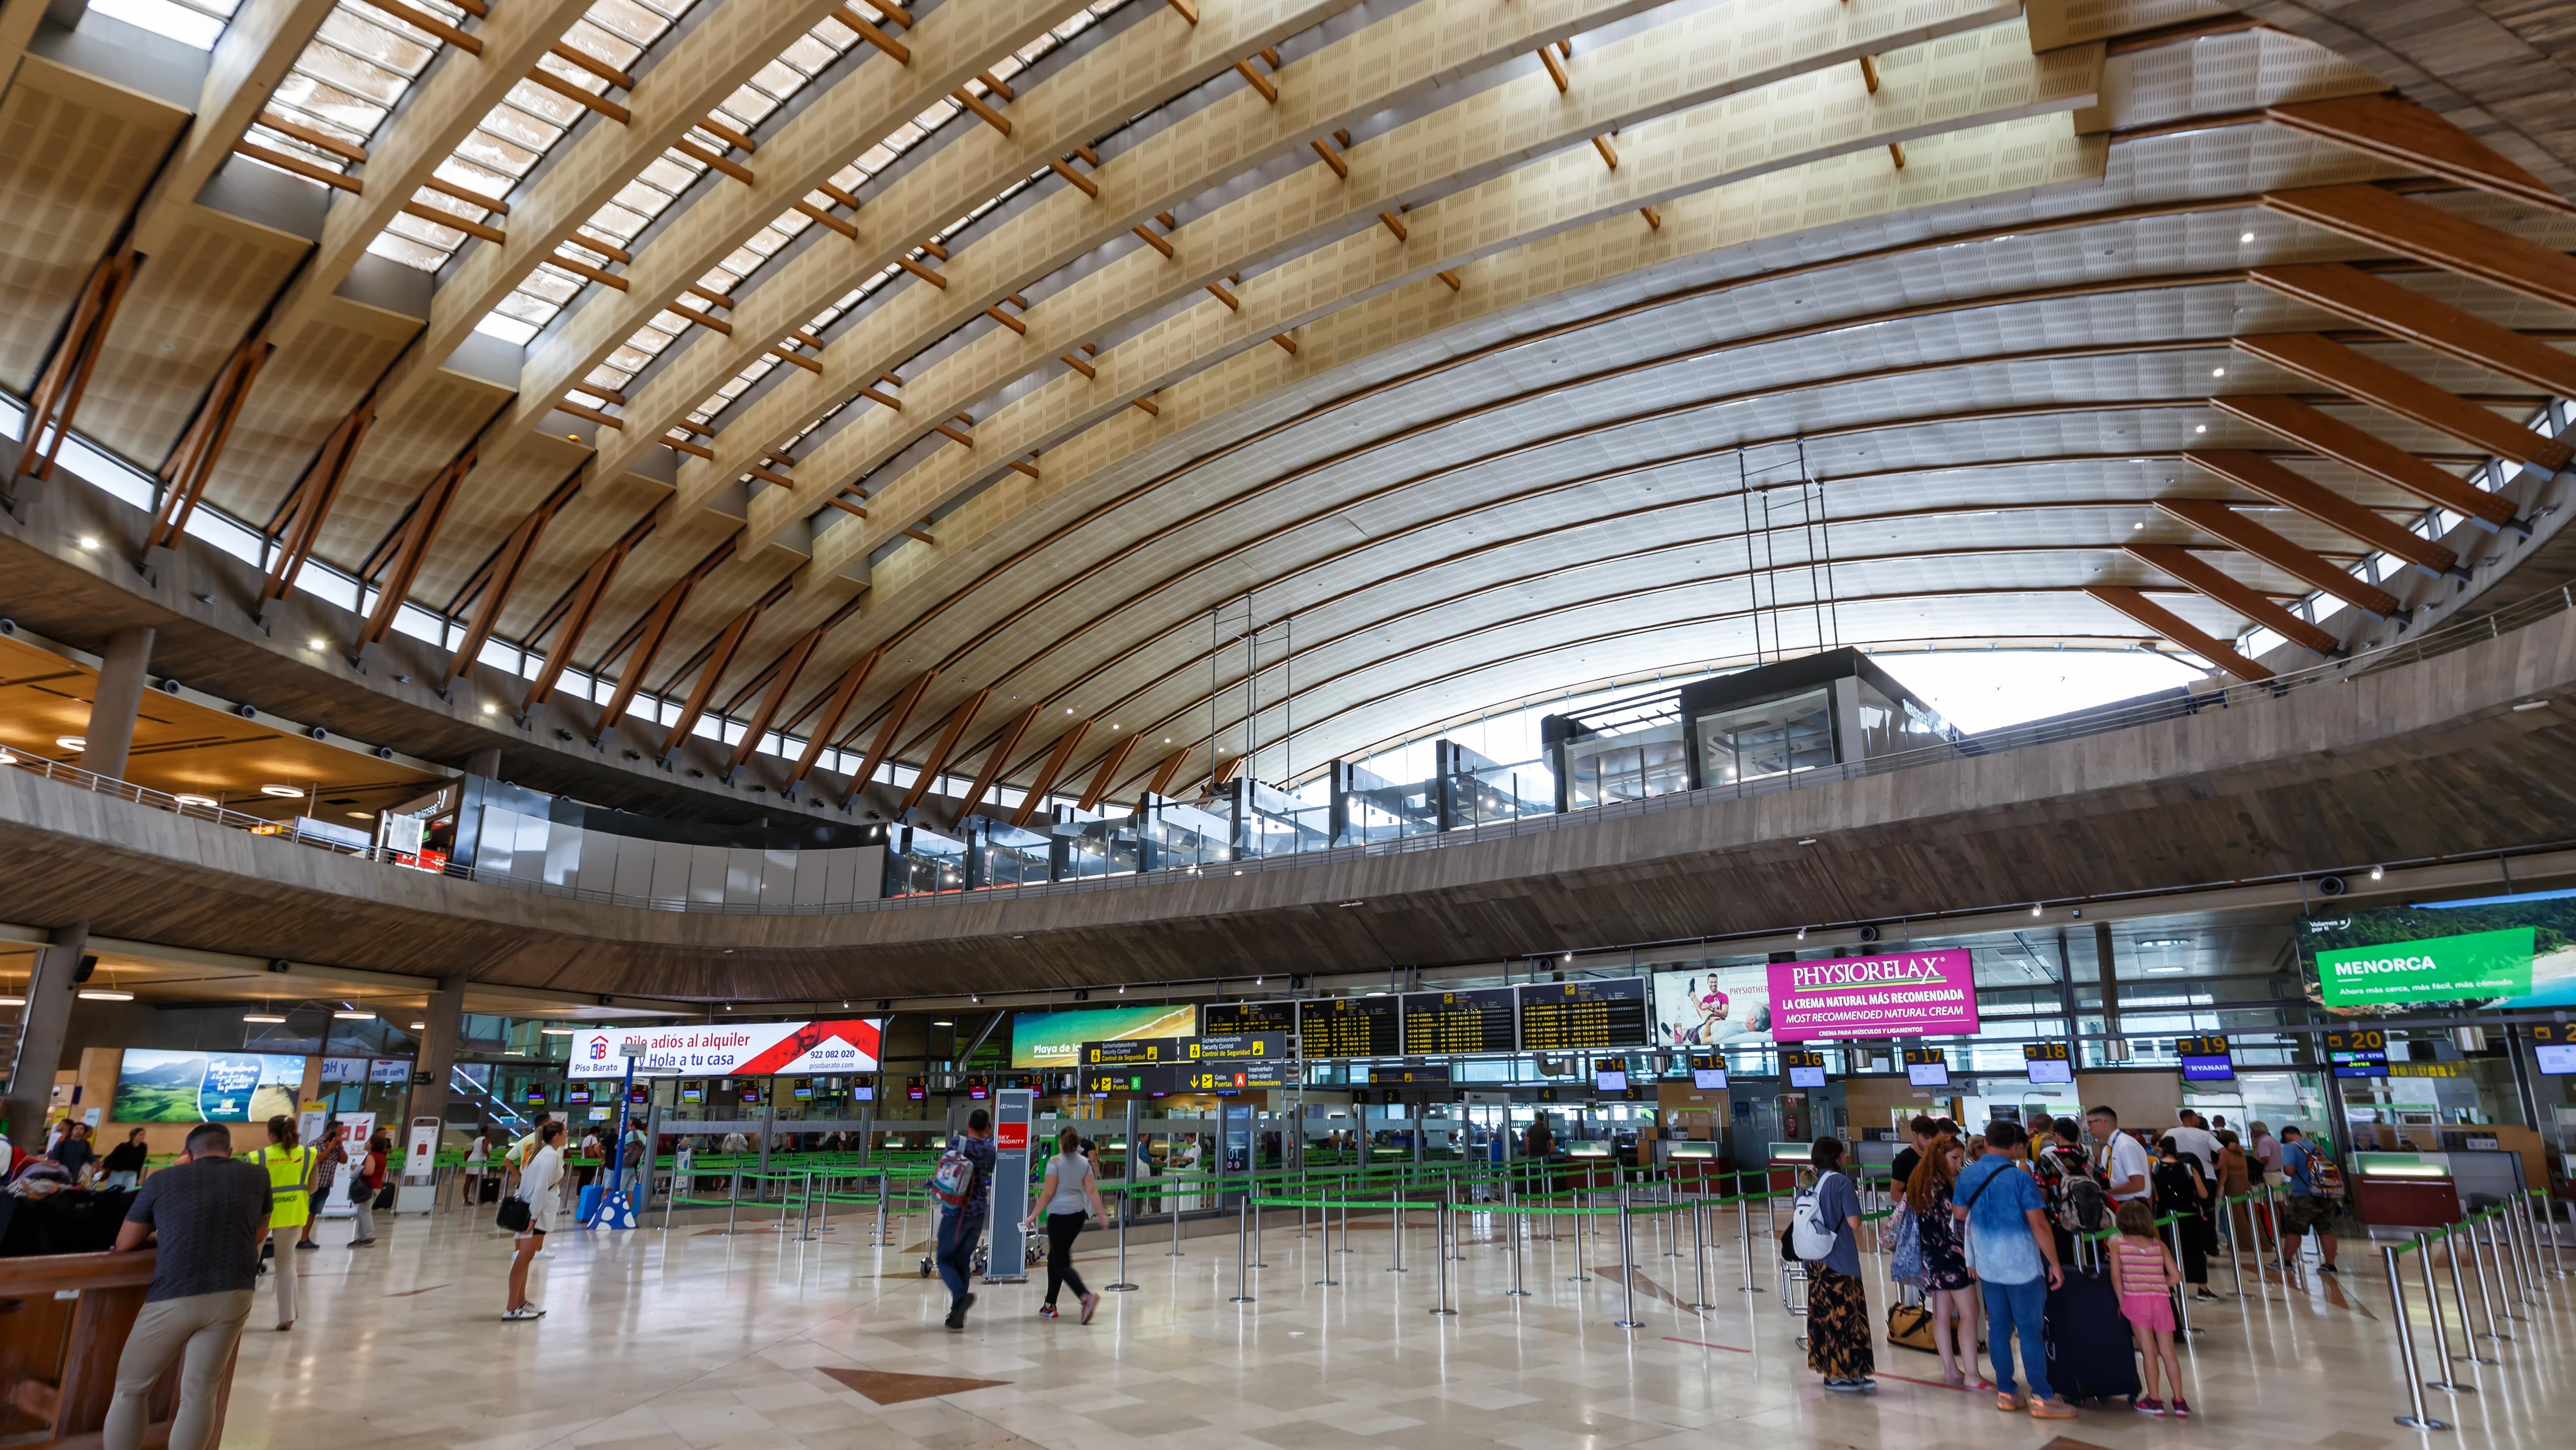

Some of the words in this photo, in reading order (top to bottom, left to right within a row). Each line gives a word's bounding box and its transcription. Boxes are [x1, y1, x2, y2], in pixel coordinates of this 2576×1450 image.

[2335, 956, 2436, 975] MENORCA
[2476, 979, 2513, 987] cómodo
[1782, 1000, 1793, 1010] LA
[1795, 997, 1825, 1009] CREMA
[1826, 995, 1867, 1007] NATURAL
[1869, 992, 1890, 1005] MÁS
[1892, 989, 1964, 1003] RECOMENDADA
[1786, 1014, 1811, 1024] MOST
[1812, 1010, 1883, 1022] RECOMMENDED
[1885, 1008, 1927, 1020] NATURAL
[1929, 1006, 1963, 1017] CREAM
[652, 1034, 683, 1048] adiós
[688, 1034, 698, 1047] al
[702, 1032, 750, 1050] alquiler
[2201, 1037, 2225, 1053] 19
[2351, 1031, 2381, 1049] 20
[1034, 1044, 1057, 1055] Playa
[1061, 1044, 1070, 1052] de
[2044, 1045, 2066, 1059] 18
[650, 1053, 675, 1067] Hola
[680, 1055, 686, 1066] a
[691, 1053, 703, 1065] tu
[708, 1053, 734, 1065] casa
[1708, 1056, 1724, 1068] 15
[1804, 1053, 1822, 1066] 16
[1922, 1050, 1941, 1063] 17
[575, 1064, 590, 1072] Piso
[809, 1062, 853, 1070] pisobarato.com
[1611, 1059, 1624, 1070] 14
[920, 1077, 924, 1085] 8
[983, 1076, 987, 1085] 9
[1032, 1076, 1041, 1084] 10
[1134, 1079, 1138, 1088] B
[1237, 1076, 1243, 1085] A
[1388, 1093, 1393, 1101] 2
[1543, 1090, 1549, 1099] 4
[1628, 1089, 1634, 1098] 5
[1229, 1149, 1238, 1160] 01
